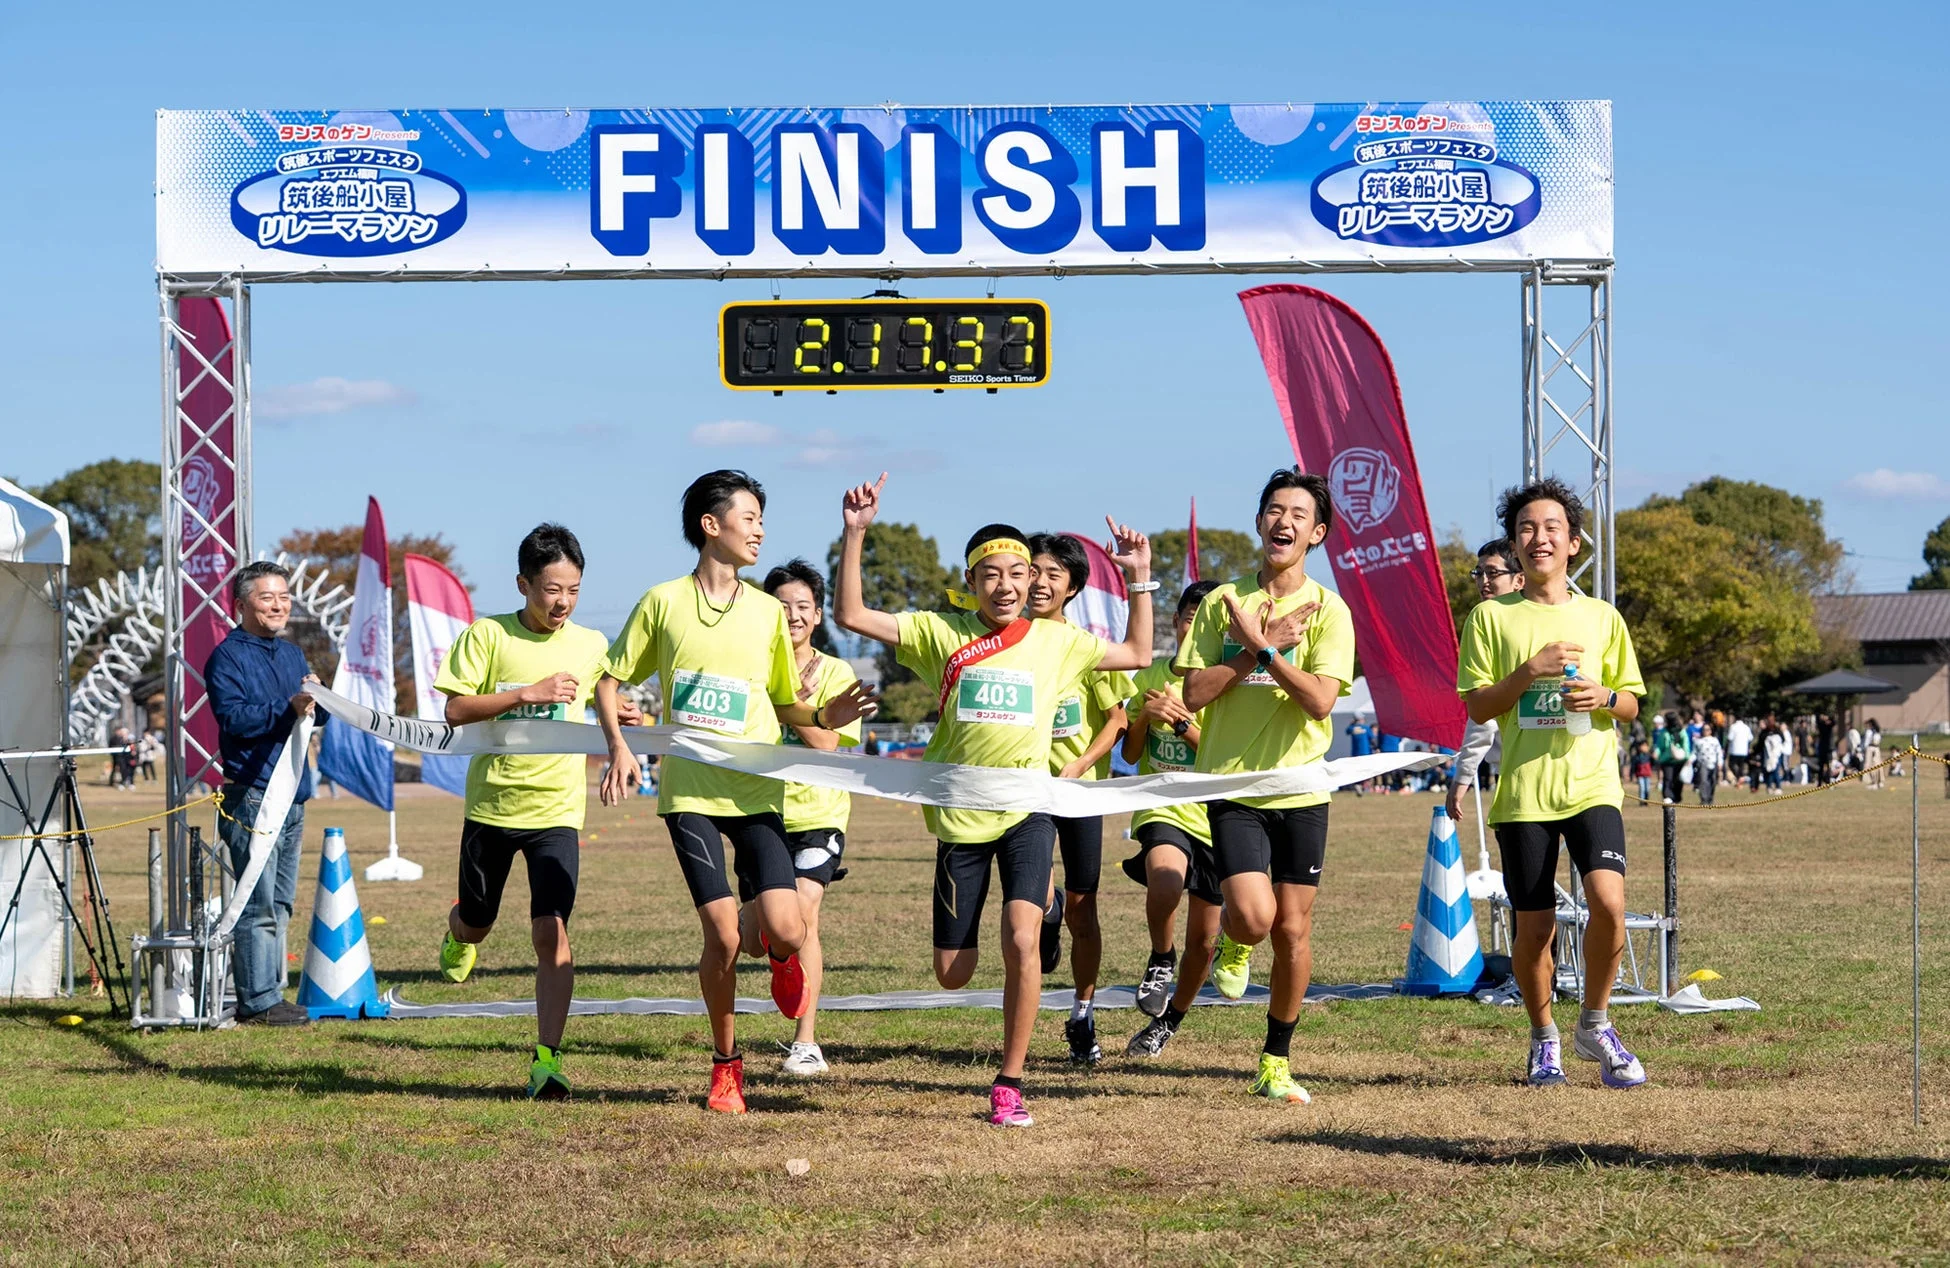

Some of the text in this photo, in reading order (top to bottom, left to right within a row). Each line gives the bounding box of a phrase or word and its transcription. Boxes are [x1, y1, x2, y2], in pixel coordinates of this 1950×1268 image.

[280, 126, 419, 141] タンスのゲン Presents
[1356, 116, 1493, 132] タンスのゲン Presents
[282, 149, 416, 171] 筑後スポーツフェスタ
[1360, 140, 1491, 162] 筑後スポーツフェスタ
[598, 129, 1181, 231] FINISH
[1364, 174, 1486, 201] 筑後船小屋
[286, 183, 408, 210] 筑後船小屋
[261, 215, 435, 243] リレーマラソン
[1340, 206, 1513, 234] リレーマラソン
[794, 316, 1035, 374] 2.17.37
[949, 374, 1037, 384] SEIKO Sports Timer
[945, 634, 1004, 681] Universal
[687, 688, 731, 714] 403
[974, 682, 1018, 707] 403
[1534, 692, 1563, 712] 40
[687, 714, 727, 727] タンスのゲン
[976, 711, 1016, 721] タンスのゲン
[1536, 718, 1566, 726] タンスの
[386, 715, 434, 749] FINISH
[1156, 741, 1187, 761] 403
